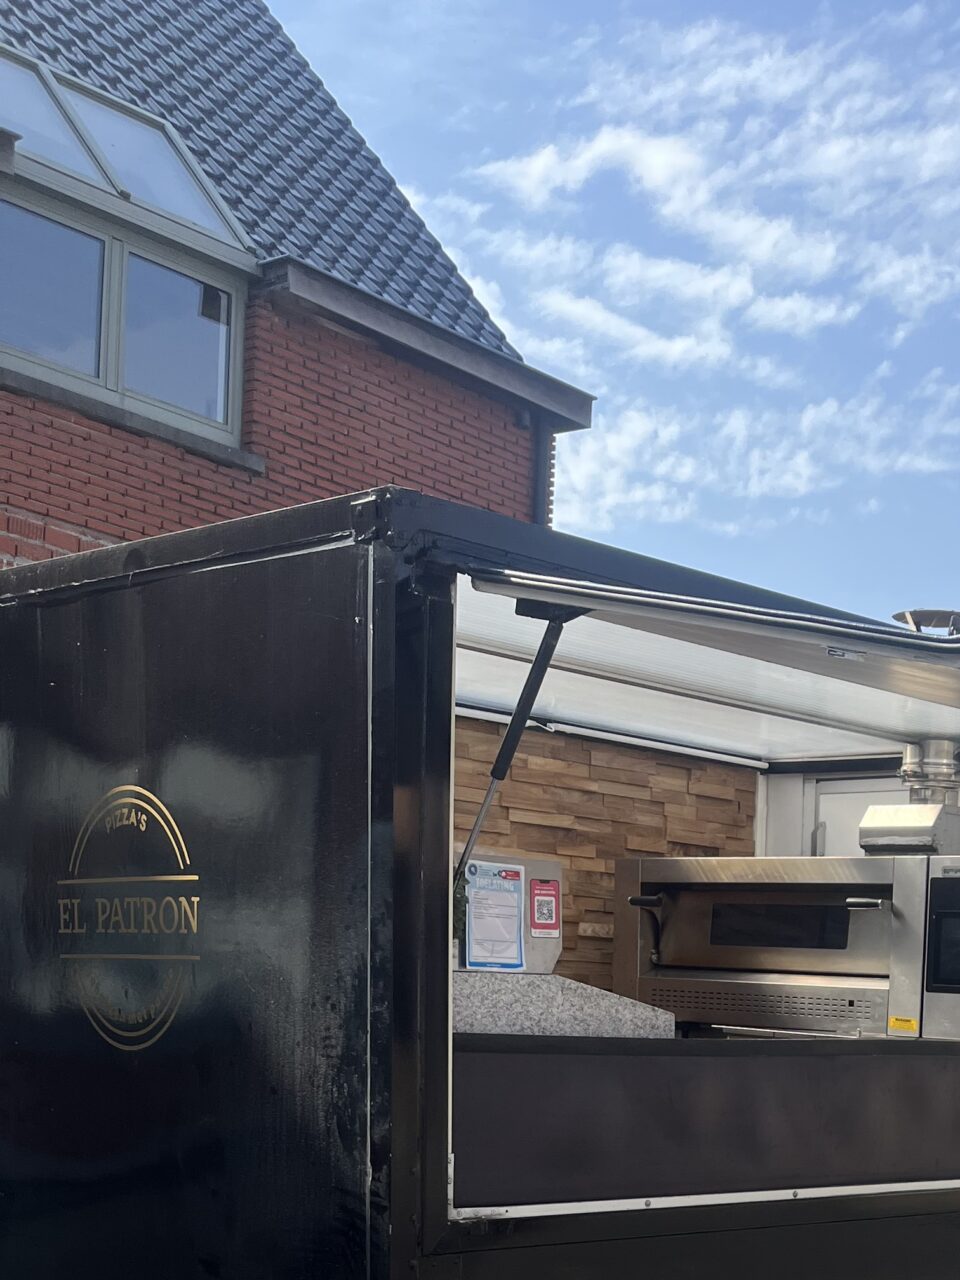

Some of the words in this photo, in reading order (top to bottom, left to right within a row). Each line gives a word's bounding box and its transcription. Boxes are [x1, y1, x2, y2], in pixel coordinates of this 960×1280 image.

[104, 807, 148, 834] PIZZA'S
[58, 898, 87, 934] EL
[95, 896, 200, 934] PATRON
